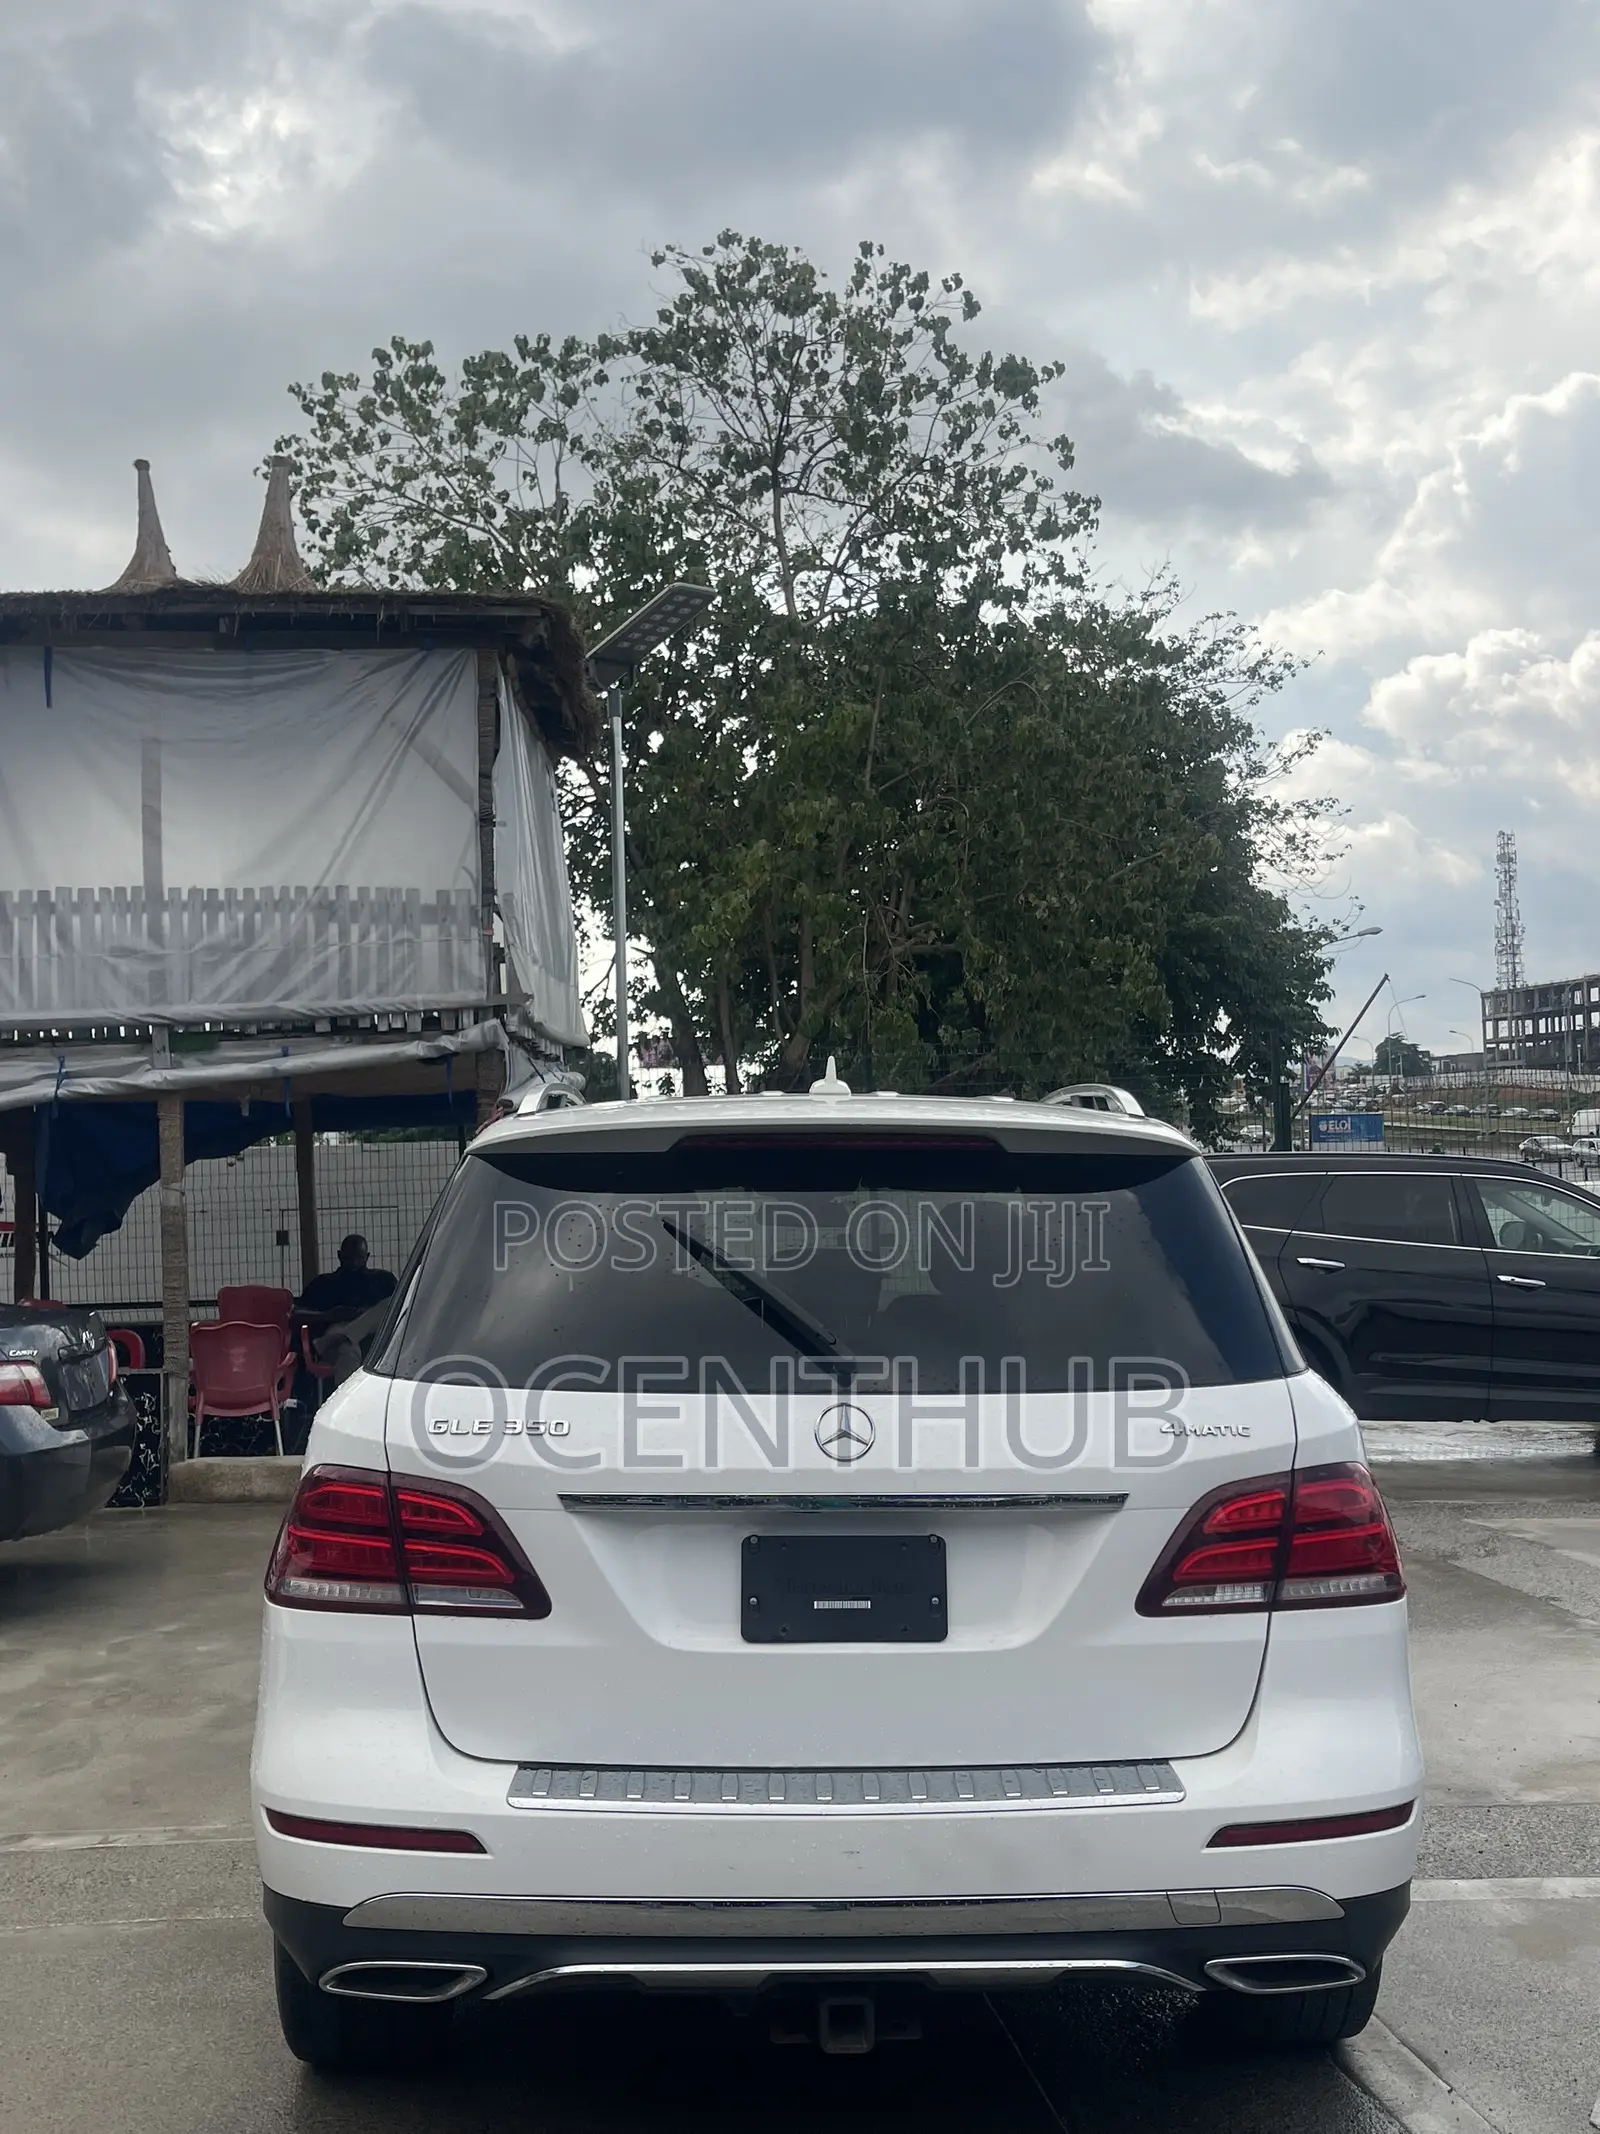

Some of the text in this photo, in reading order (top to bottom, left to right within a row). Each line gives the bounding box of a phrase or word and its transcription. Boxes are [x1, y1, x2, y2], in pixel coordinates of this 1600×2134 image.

[9, 1349, 38, 1357] CAMRY
[428, 1418, 571, 1437] GLE 350
[1160, 1421, 1251, 1438] 4MATIC
